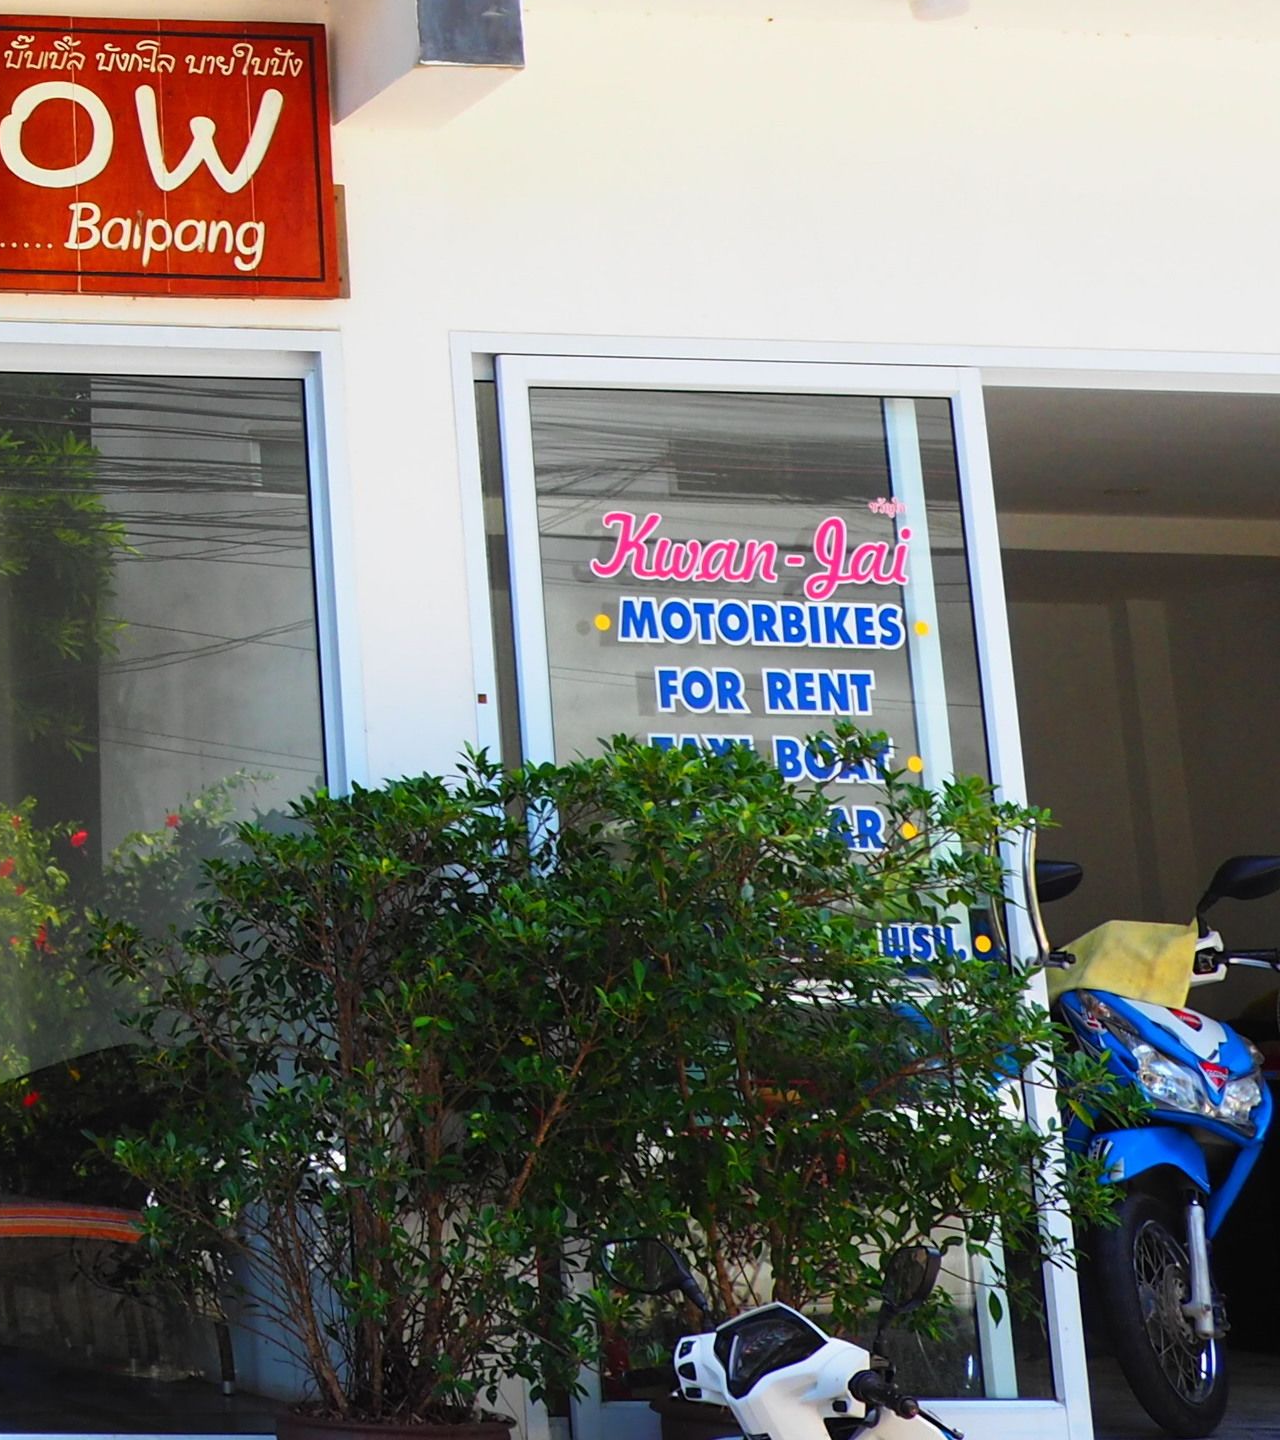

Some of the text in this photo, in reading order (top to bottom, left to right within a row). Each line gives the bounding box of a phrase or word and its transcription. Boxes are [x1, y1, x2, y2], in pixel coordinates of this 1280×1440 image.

[95, 39, 177, 74] บังกะโล
[64, 201, 266, 271] Baipang
[590, 511, 913, 600] Kwan-Jai
[618, 596, 905, 649] MOTORBIKES
[655, 667, 875, 715] FOR RENT
[824, 805, 887, 852] AR
